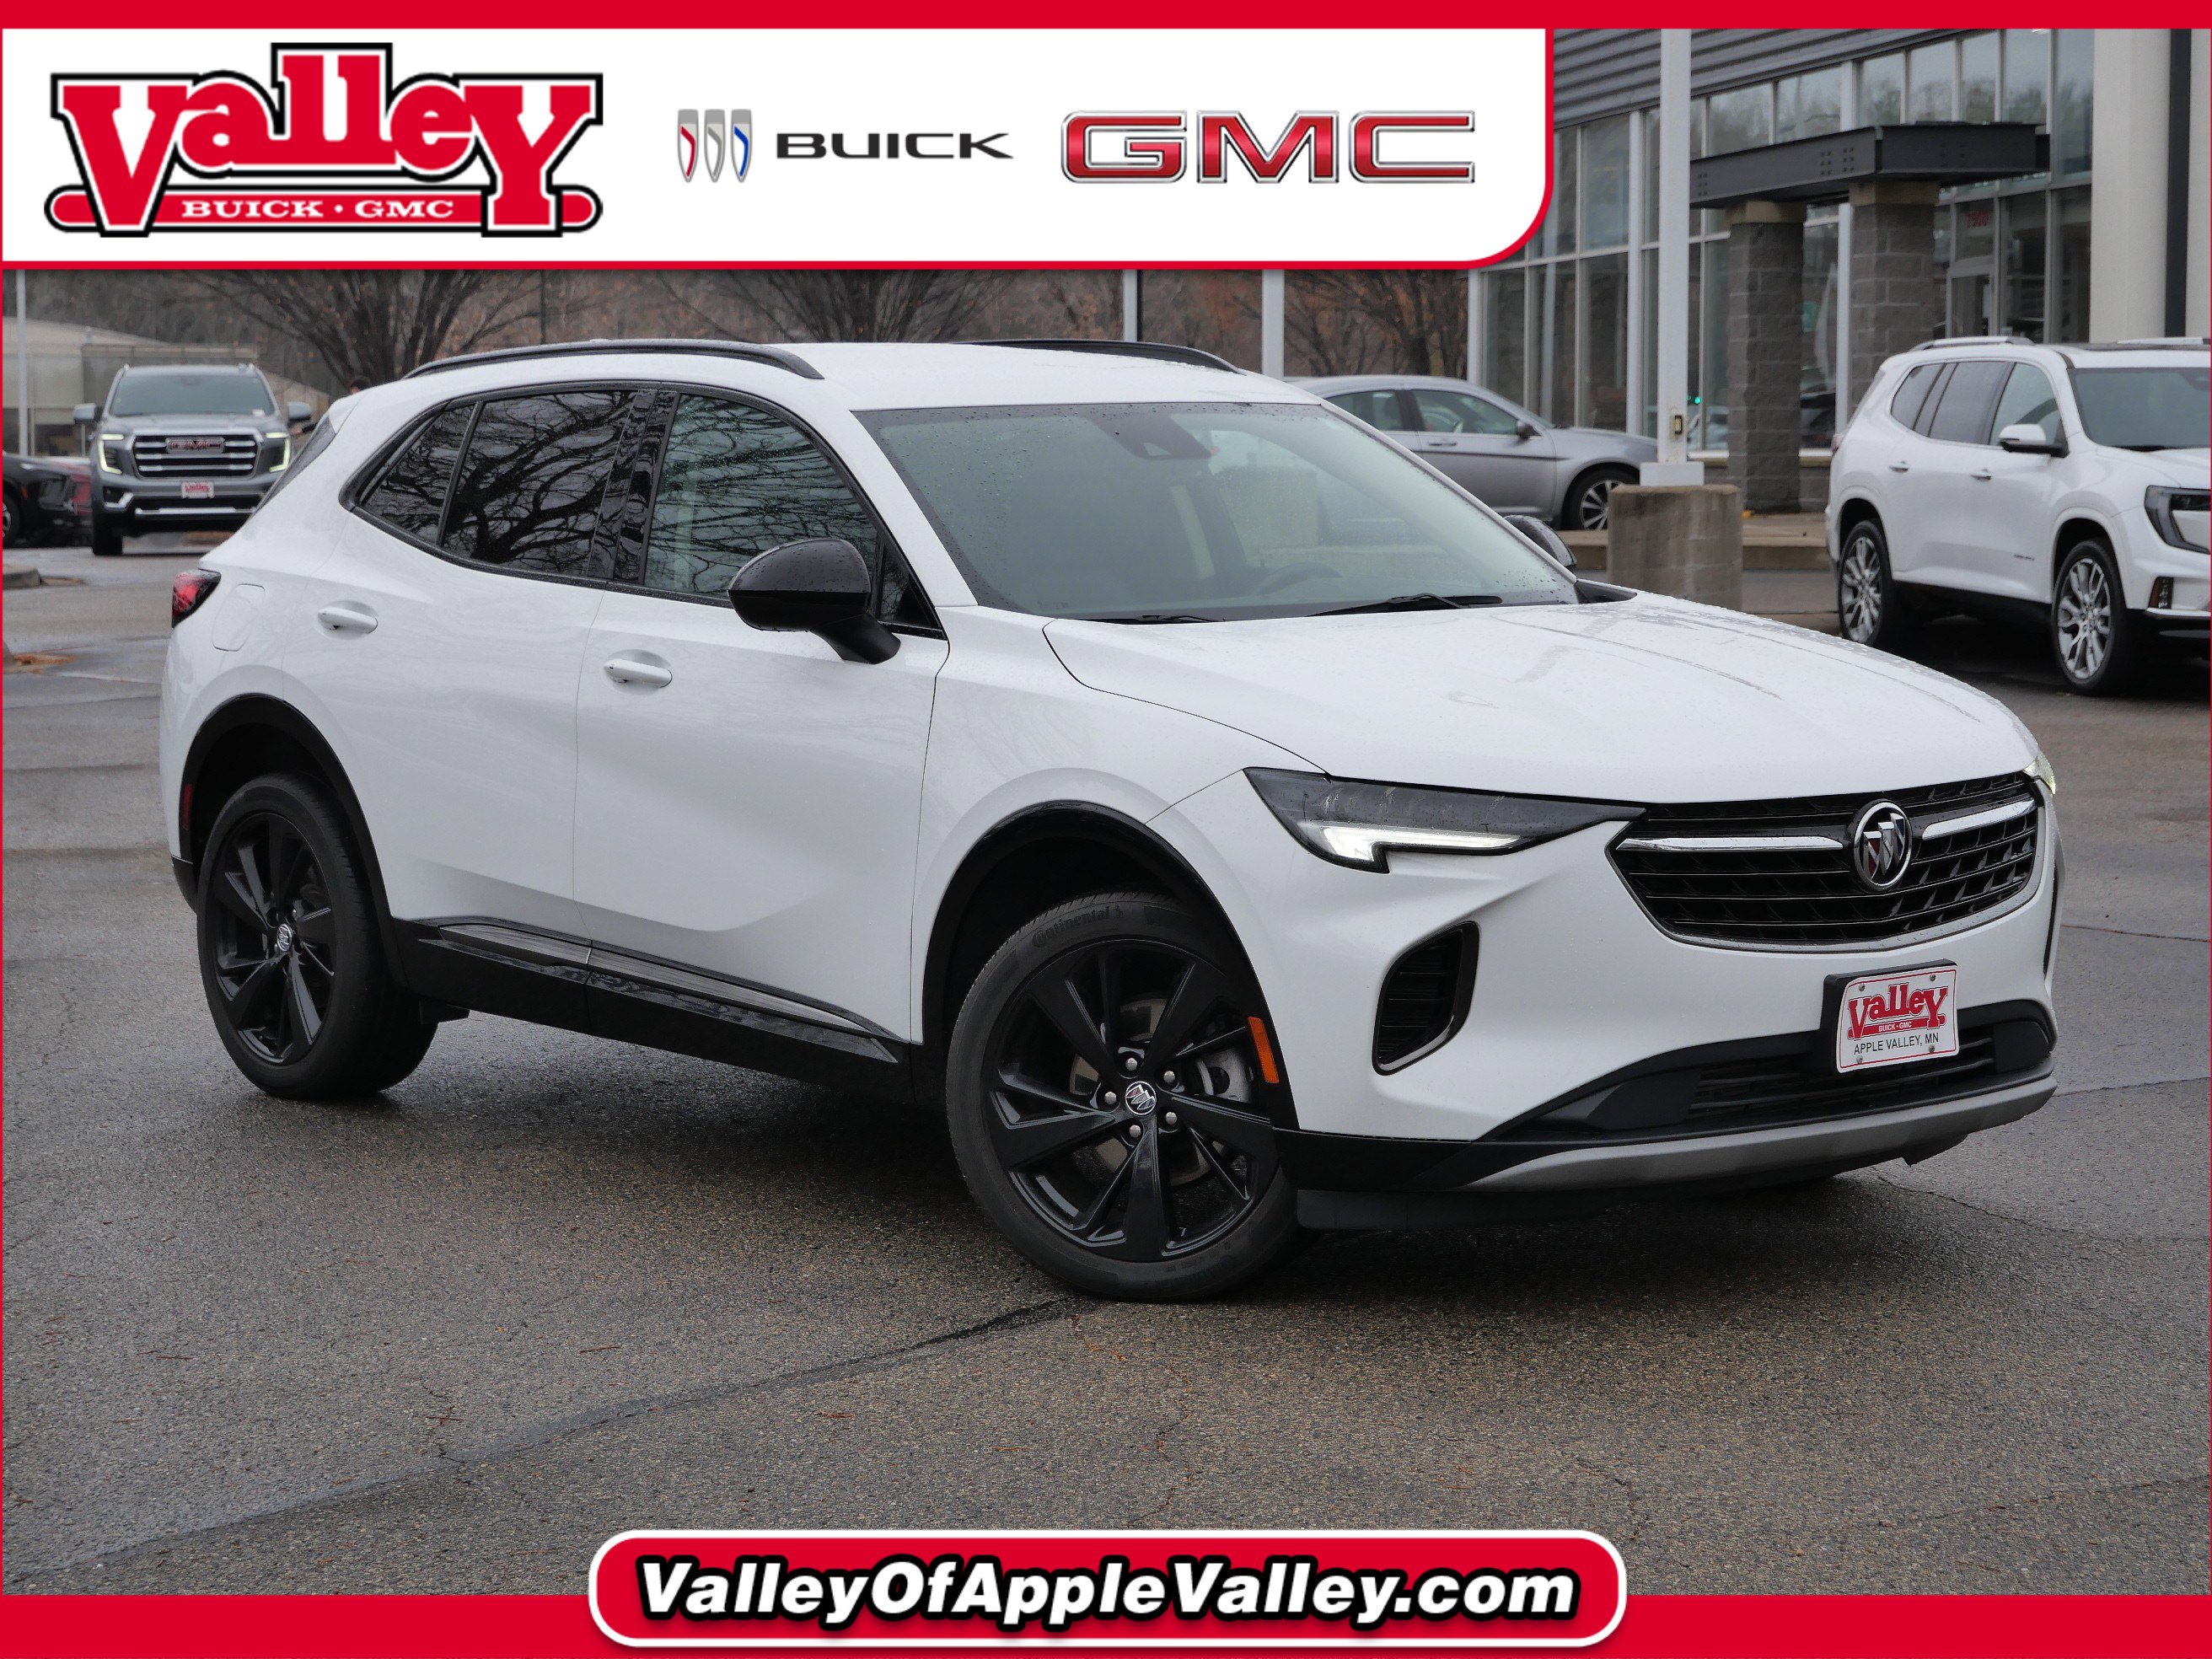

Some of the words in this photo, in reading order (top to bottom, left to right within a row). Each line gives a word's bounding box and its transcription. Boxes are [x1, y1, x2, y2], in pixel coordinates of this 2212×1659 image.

[1848, 983, 1948, 1039] Valley
[1878, 1023, 1897, 1033] BUICK
[1898, 1021, 1913, 1029] GMC
[1855, 1041, 1883, 1055] APPLE
[1886, 1036, 1923, 1048] VALLEY,
[1925, 1033, 1939, 1044] MN
